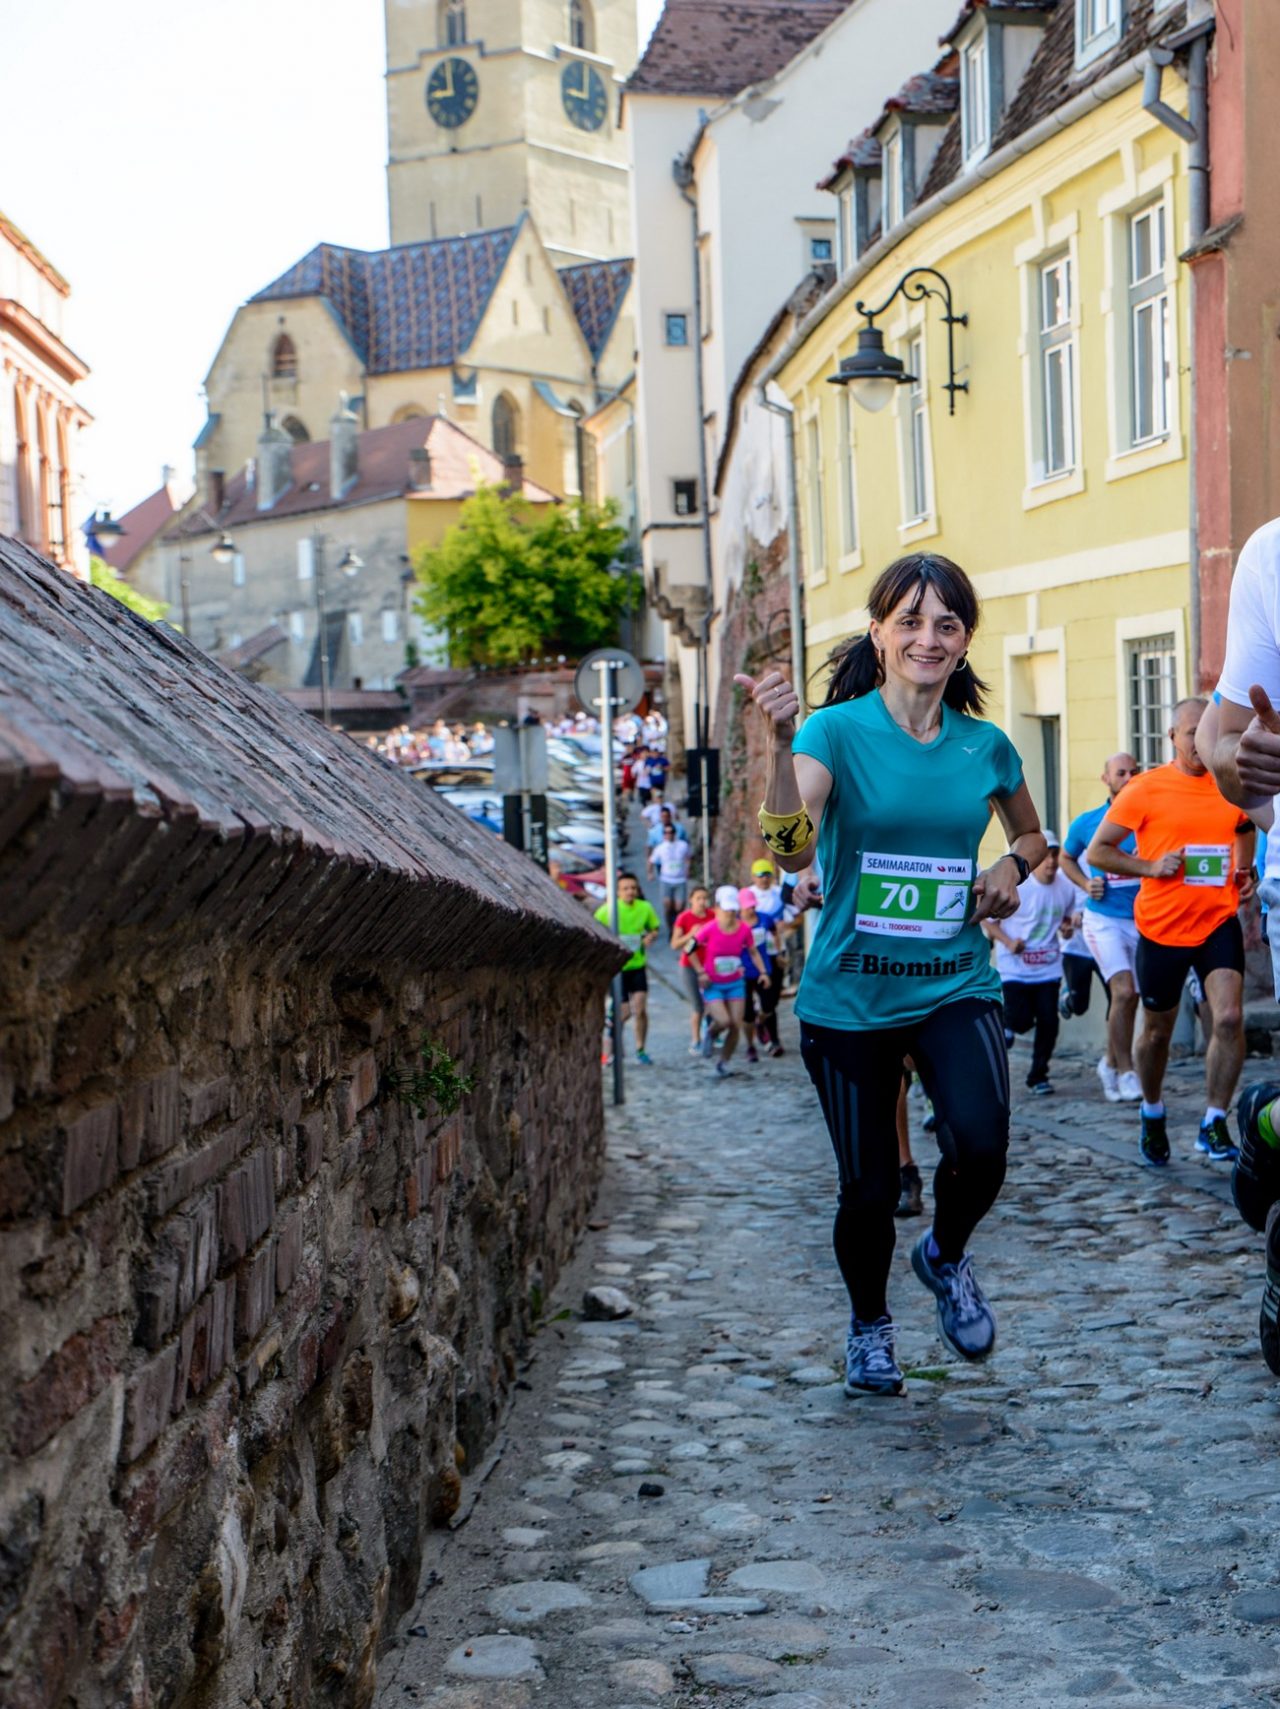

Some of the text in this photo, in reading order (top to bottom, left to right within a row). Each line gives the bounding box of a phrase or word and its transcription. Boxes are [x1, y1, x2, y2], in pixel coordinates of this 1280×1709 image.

[867, 858, 932, 873] SEMIMARATON
[1198, 859, 1210, 873] 6
[880, 882, 920, 912] 70
[861, 954, 957, 976] Biomin
